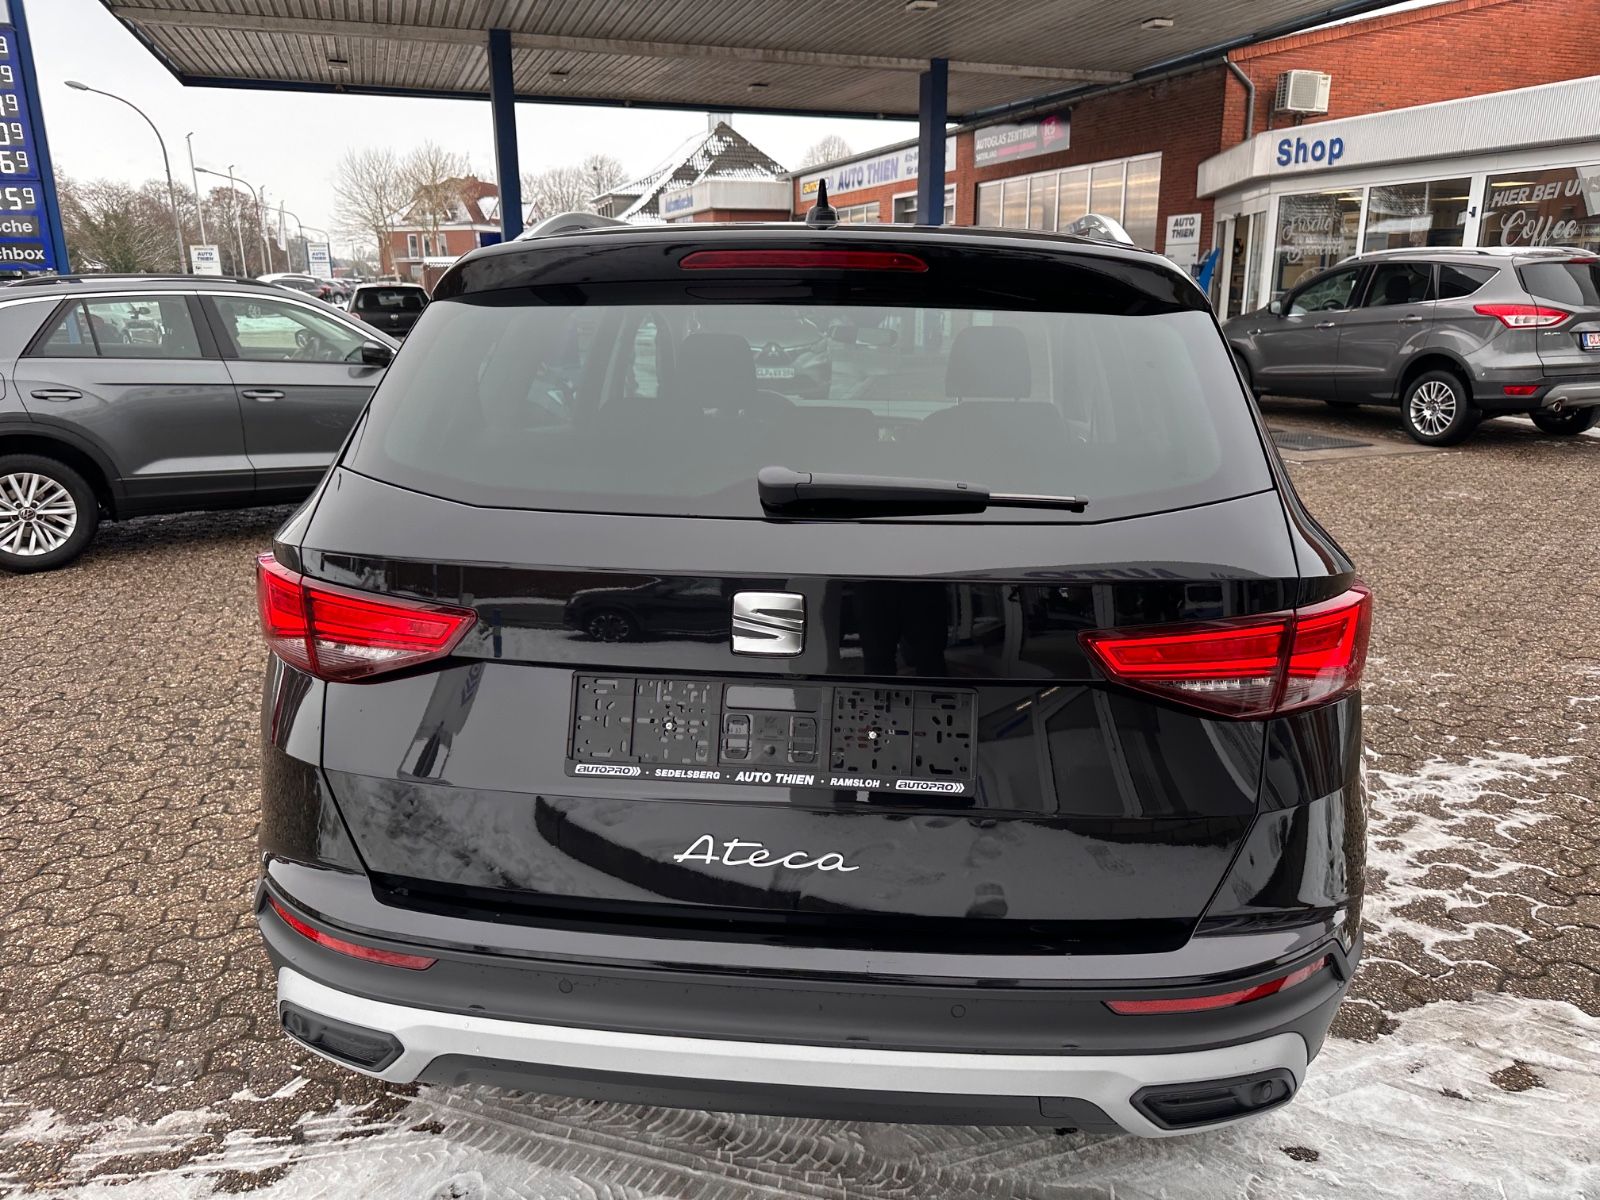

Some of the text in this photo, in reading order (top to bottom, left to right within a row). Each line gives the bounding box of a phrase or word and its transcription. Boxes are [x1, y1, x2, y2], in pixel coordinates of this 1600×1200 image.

[1007, 125, 1038, 143] ZENTRUM
[1276, 137, 1344, 167] Shop
[837, 165, 864, 191] AUTO
[866, 155, 899, 185] THIEN
[1490, 187, 1530, 208] HIER
[1532, 182, 1563, 201] BEI
[0, 220, 33, 233] che
[1172, 228, 1195, 239] THIEN
[1173, 217, 1195, 227] AUTO
[1501, 209, 1577, 248] Coffee
[654, 768, 721, 780] SEDELSBERG
[735, 770, 772, 784] AUTO
[774, 773, 815, 786] THIEN
[829, 777, 881, 788] RAMSLOH
[673, 834, 860, 872] Ateca
